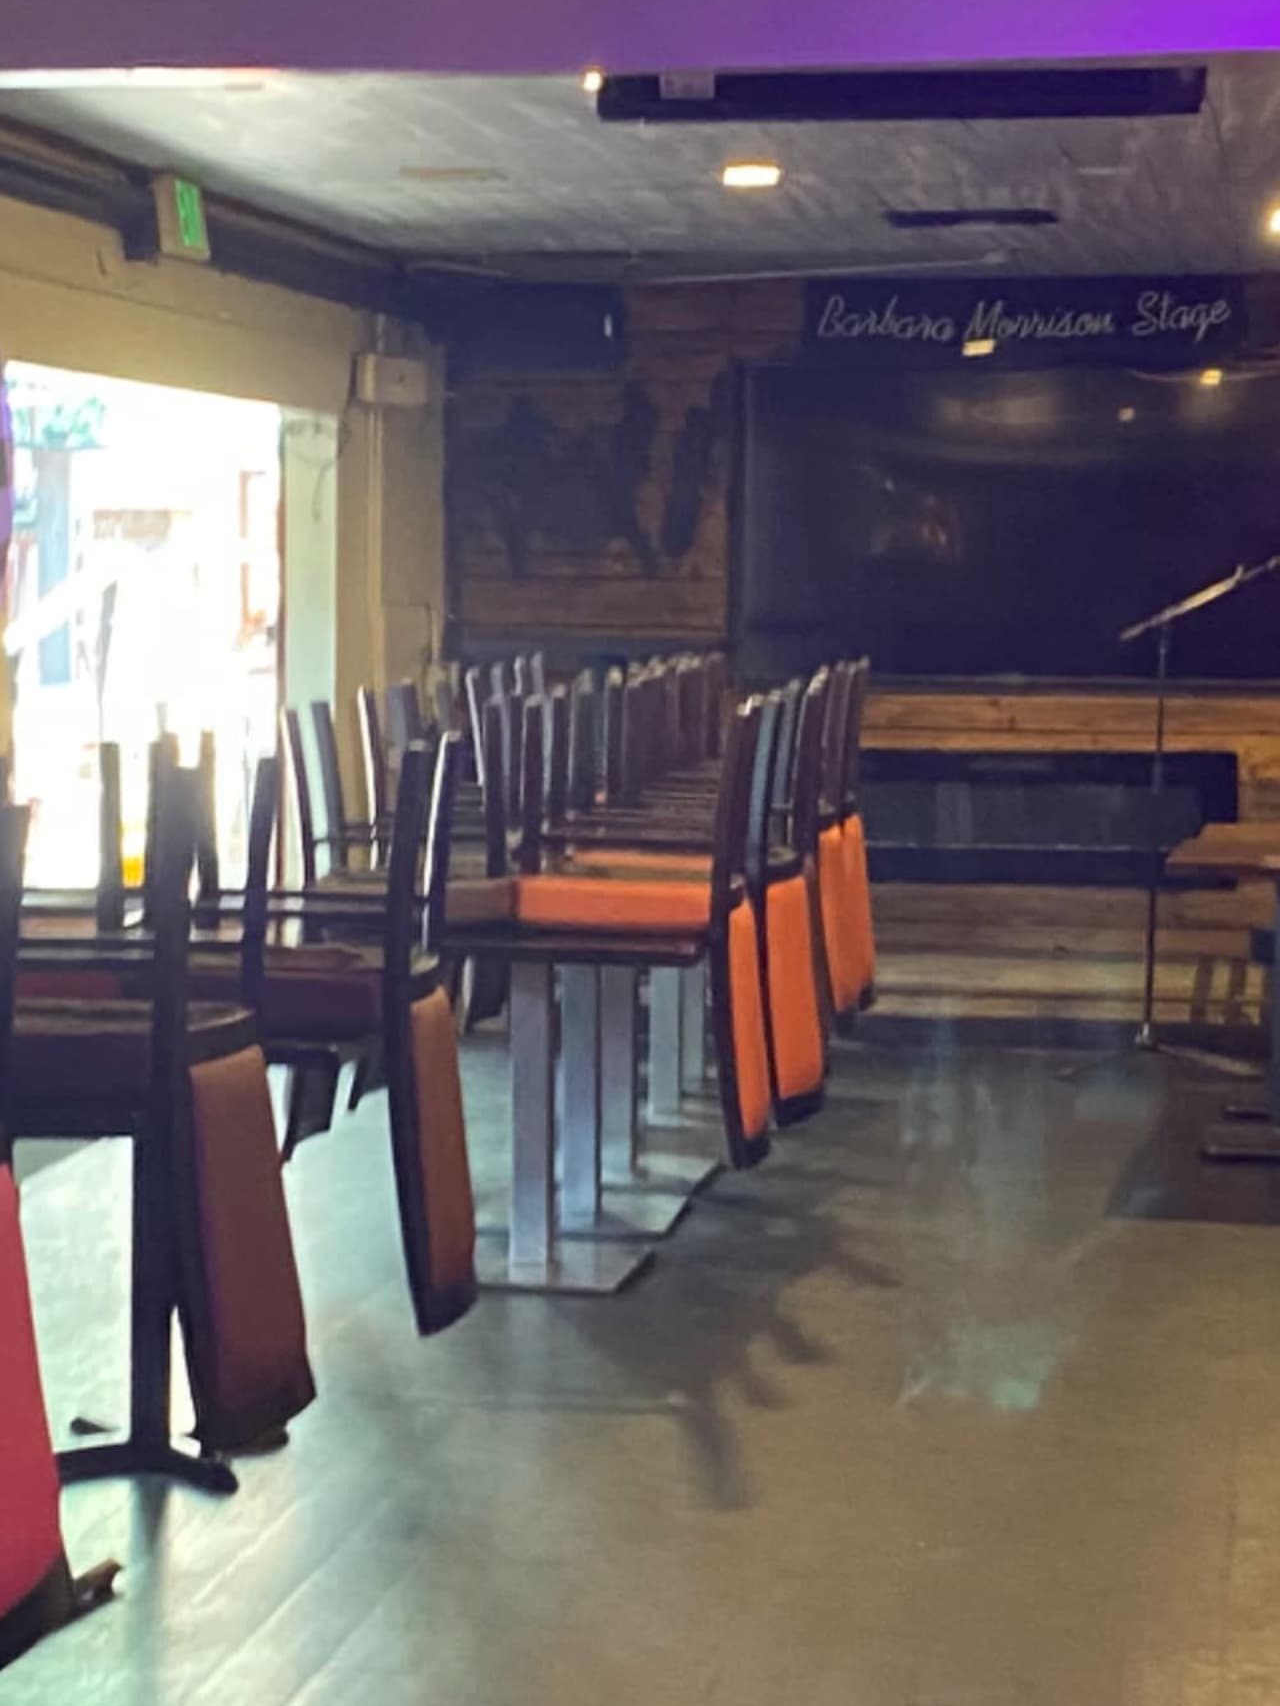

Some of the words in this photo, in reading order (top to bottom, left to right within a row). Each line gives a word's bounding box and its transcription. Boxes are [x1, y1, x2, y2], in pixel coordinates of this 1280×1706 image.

[817, 293, 956, 341] Barbara
[963, 299, 1116, 340] Morrison
[1131, 290, 1232, 345] Stage
